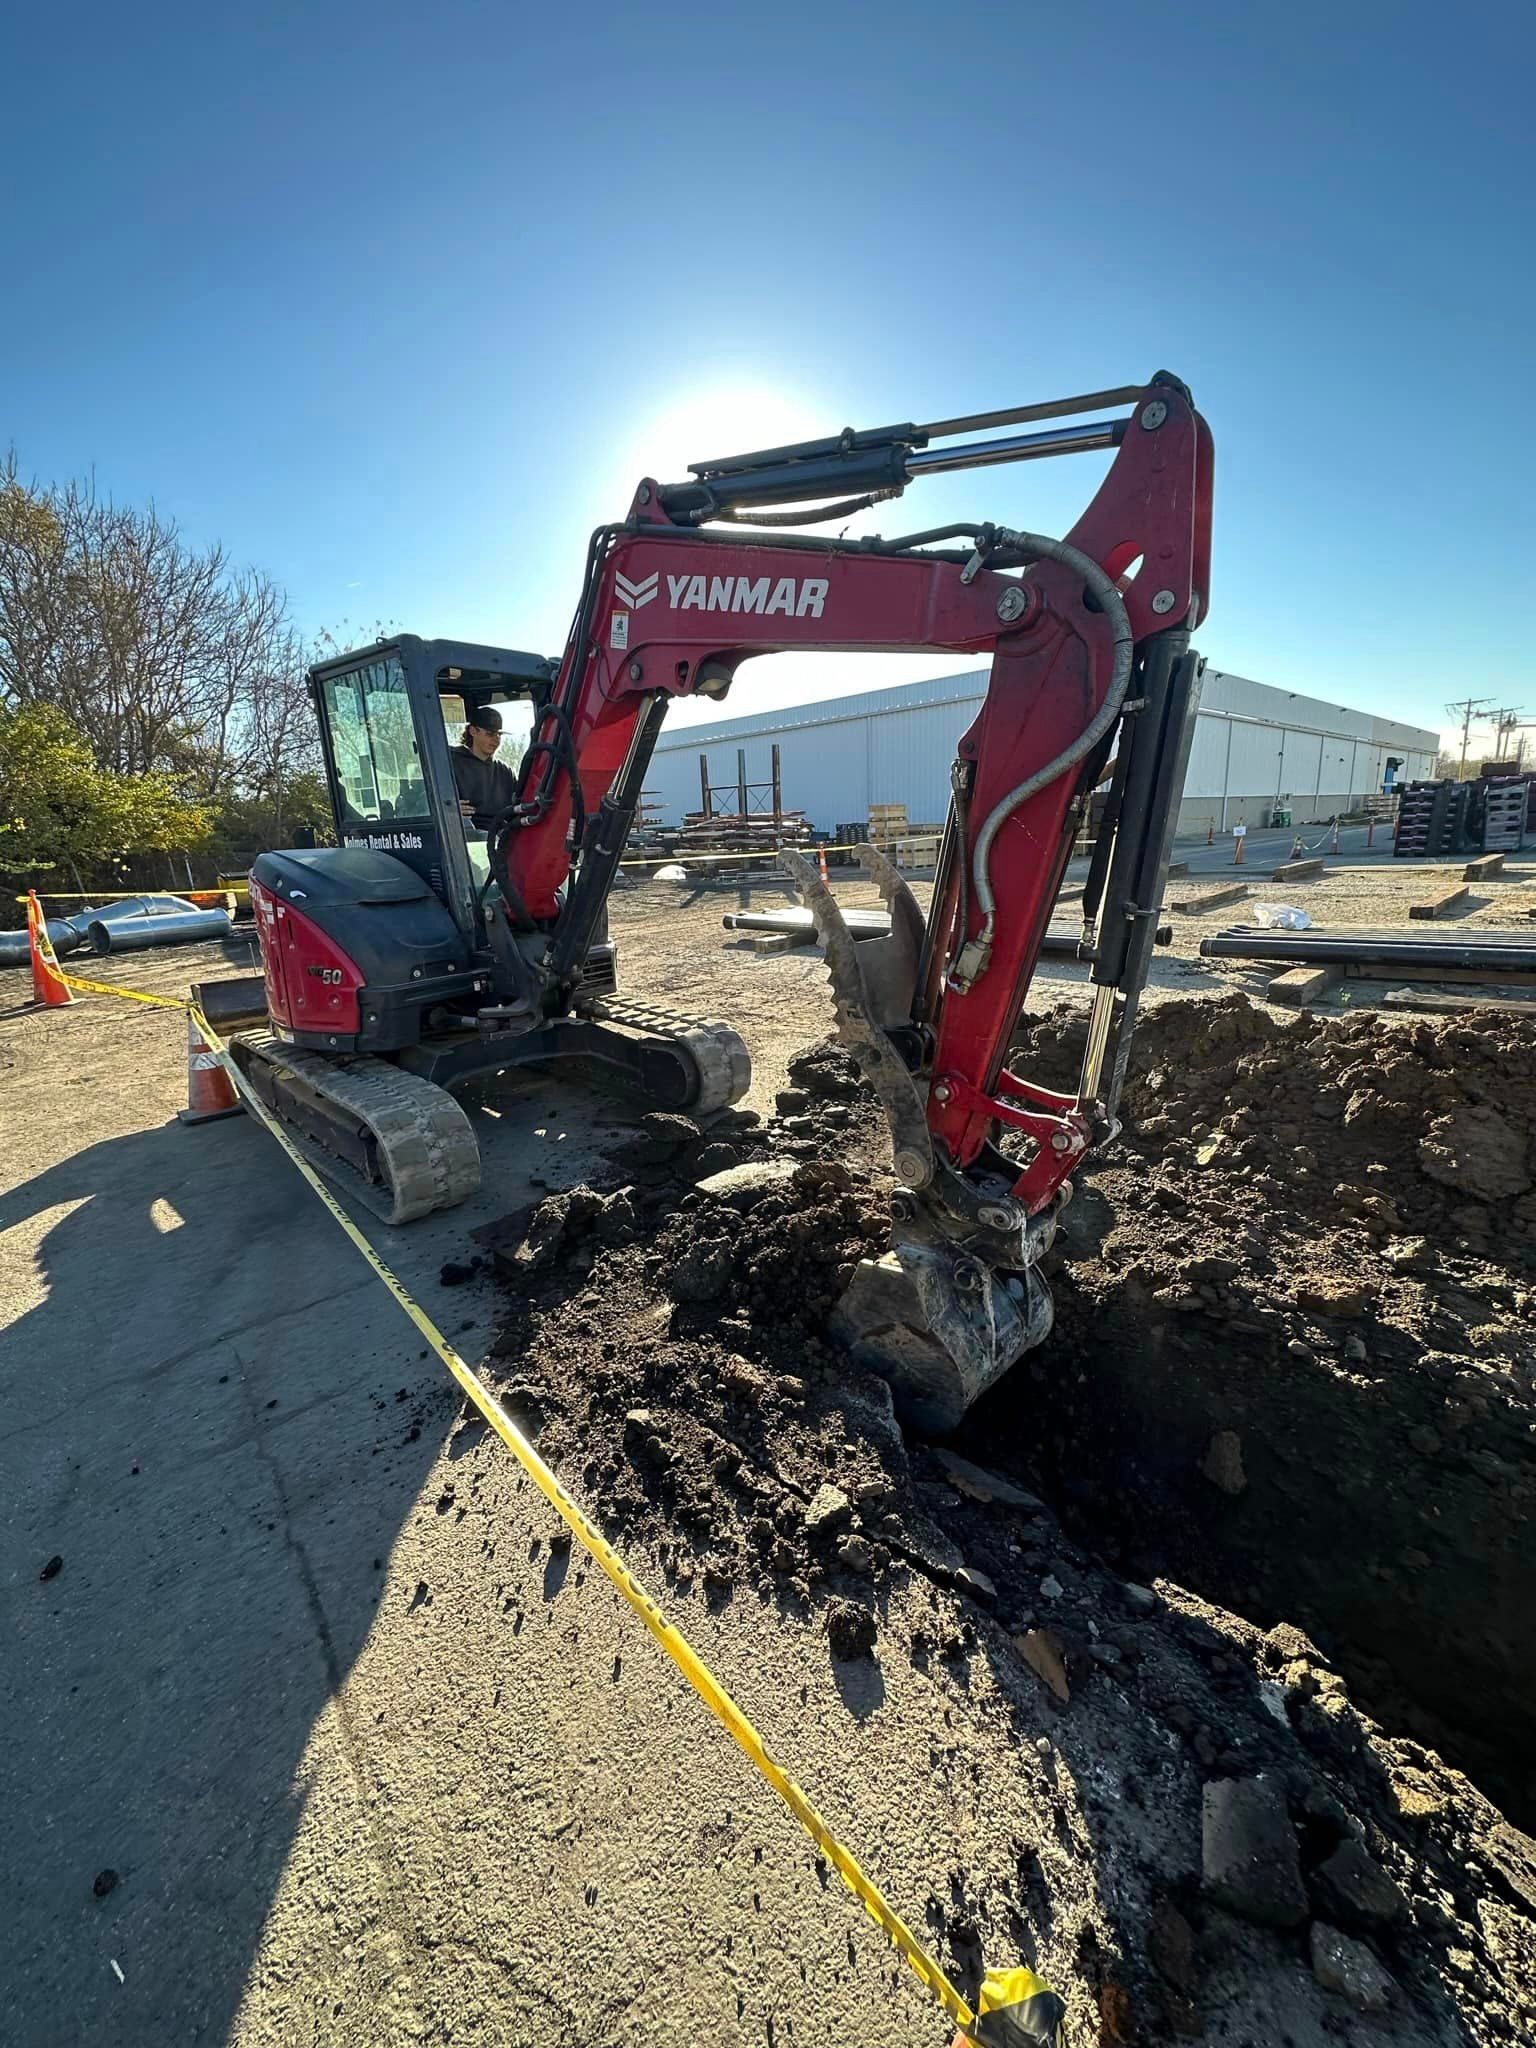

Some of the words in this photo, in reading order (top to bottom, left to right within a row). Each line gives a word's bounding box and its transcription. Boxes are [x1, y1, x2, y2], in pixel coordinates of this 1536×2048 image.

[667, 575, 829, 618] YANMAR
[369, 834, 393, 849] Rental
[393, 834, 401, 849] &
[400, 832, 423, 849] Sales
